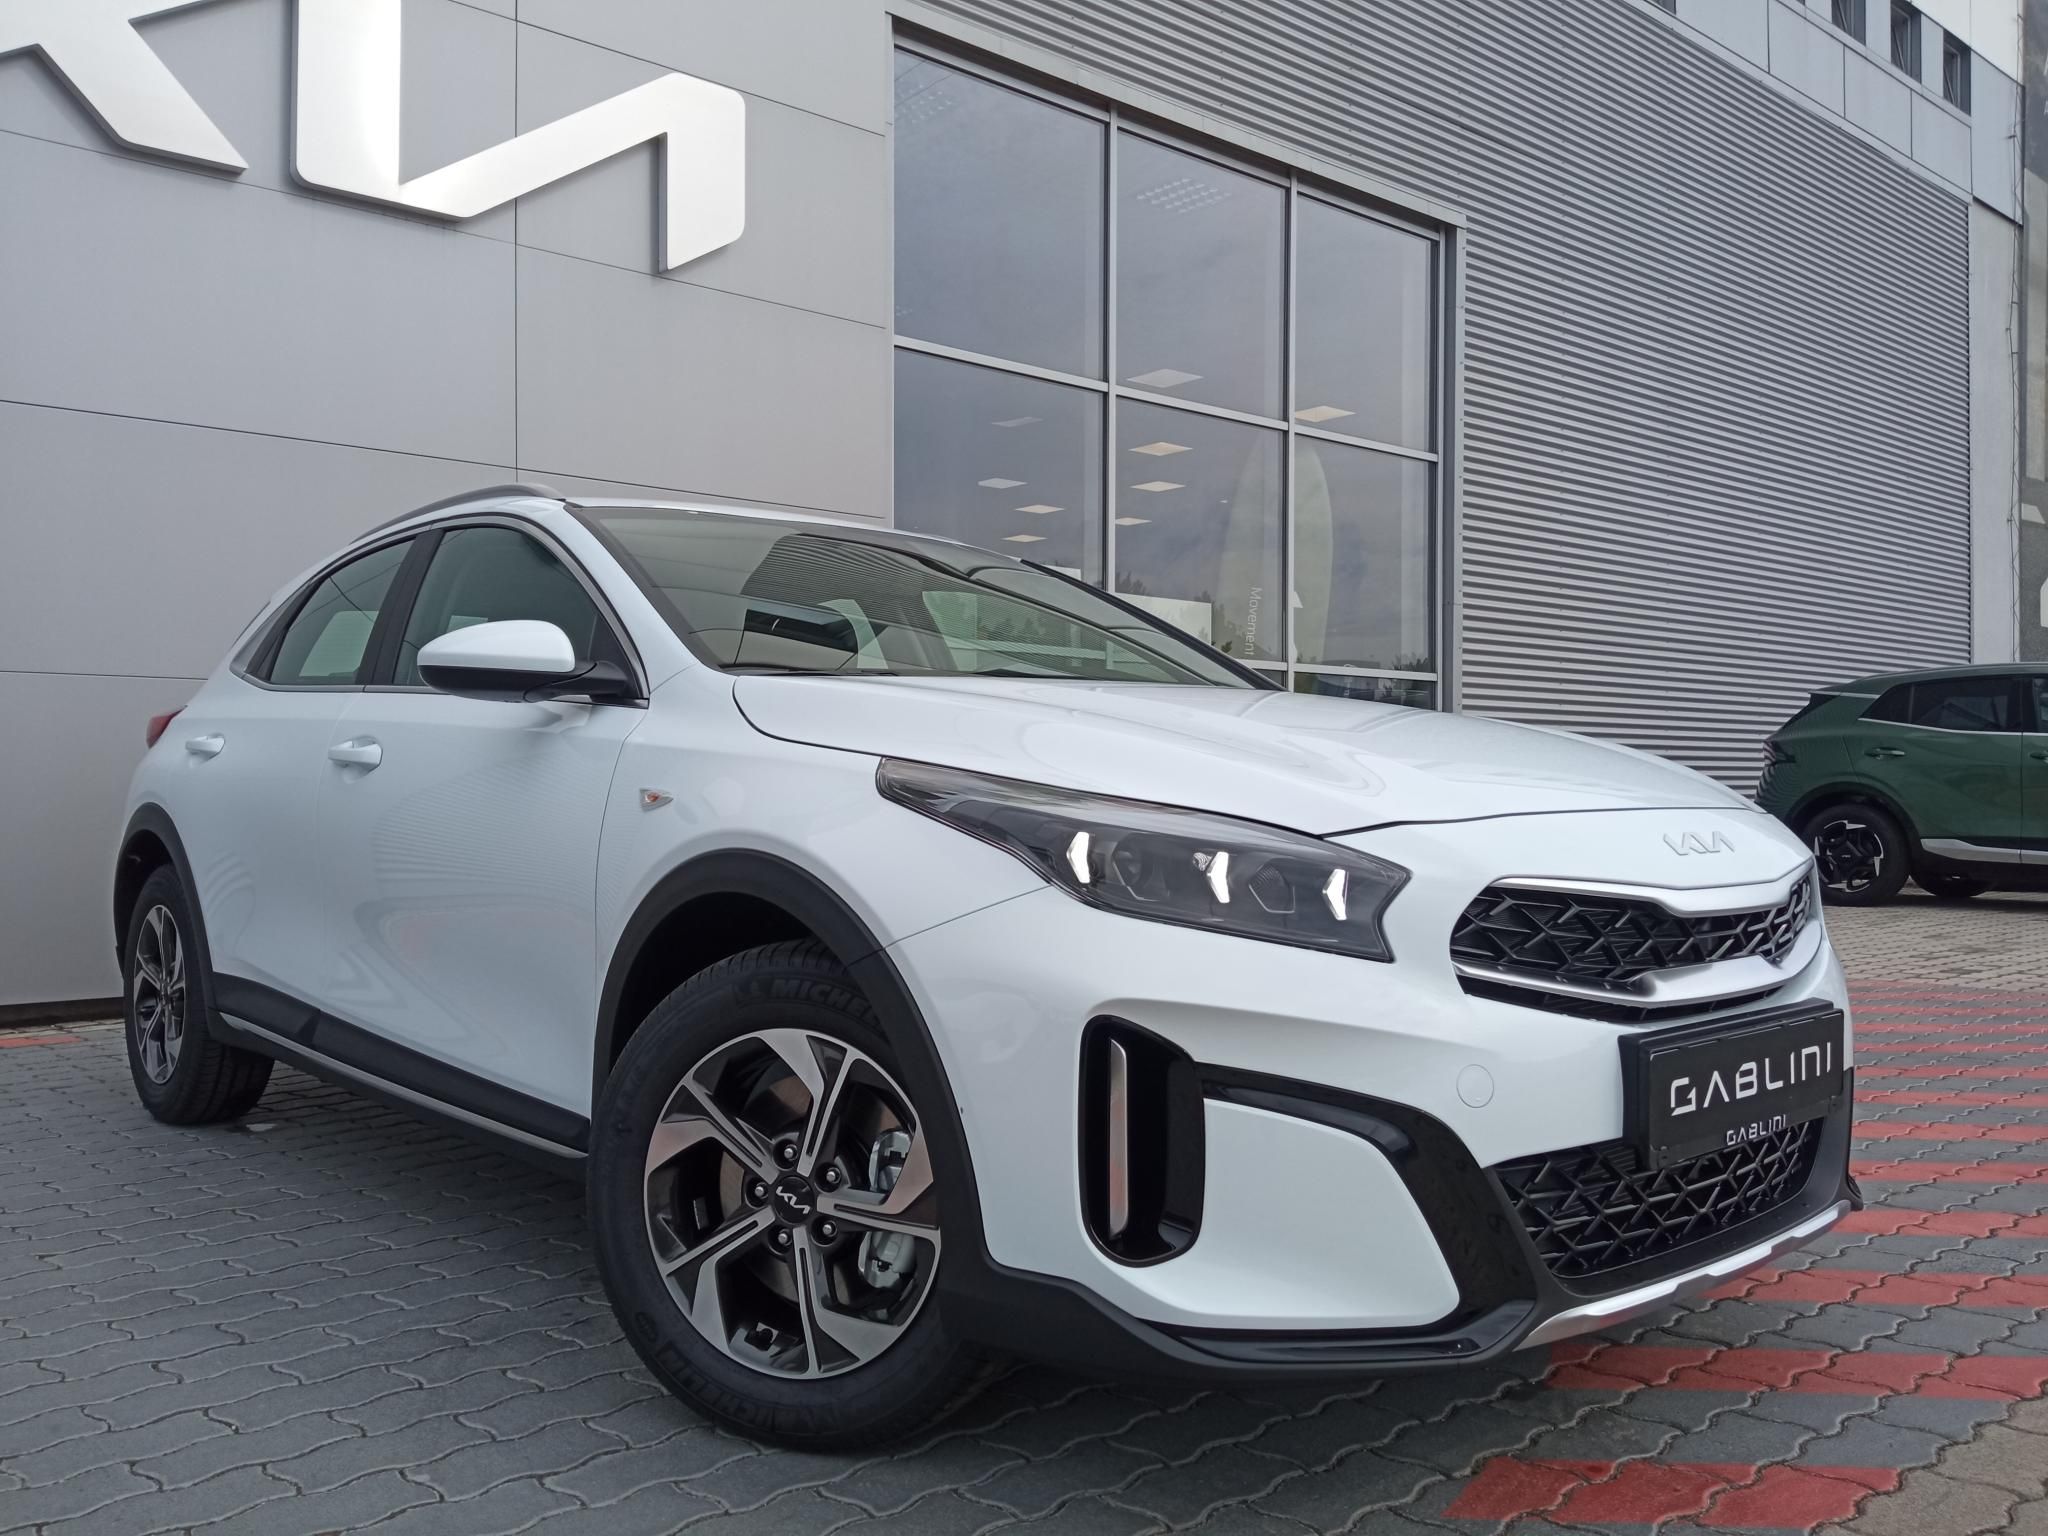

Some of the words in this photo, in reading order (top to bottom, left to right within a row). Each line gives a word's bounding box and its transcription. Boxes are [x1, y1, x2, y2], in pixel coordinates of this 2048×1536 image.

[1244, 587, 1263, 655] Movement
[1663, 831, 1735, 856] KIA
[1670, 1042, 1831, 1116] GABLINI
[1726, 1114, 1786, 1145] GABLINI
